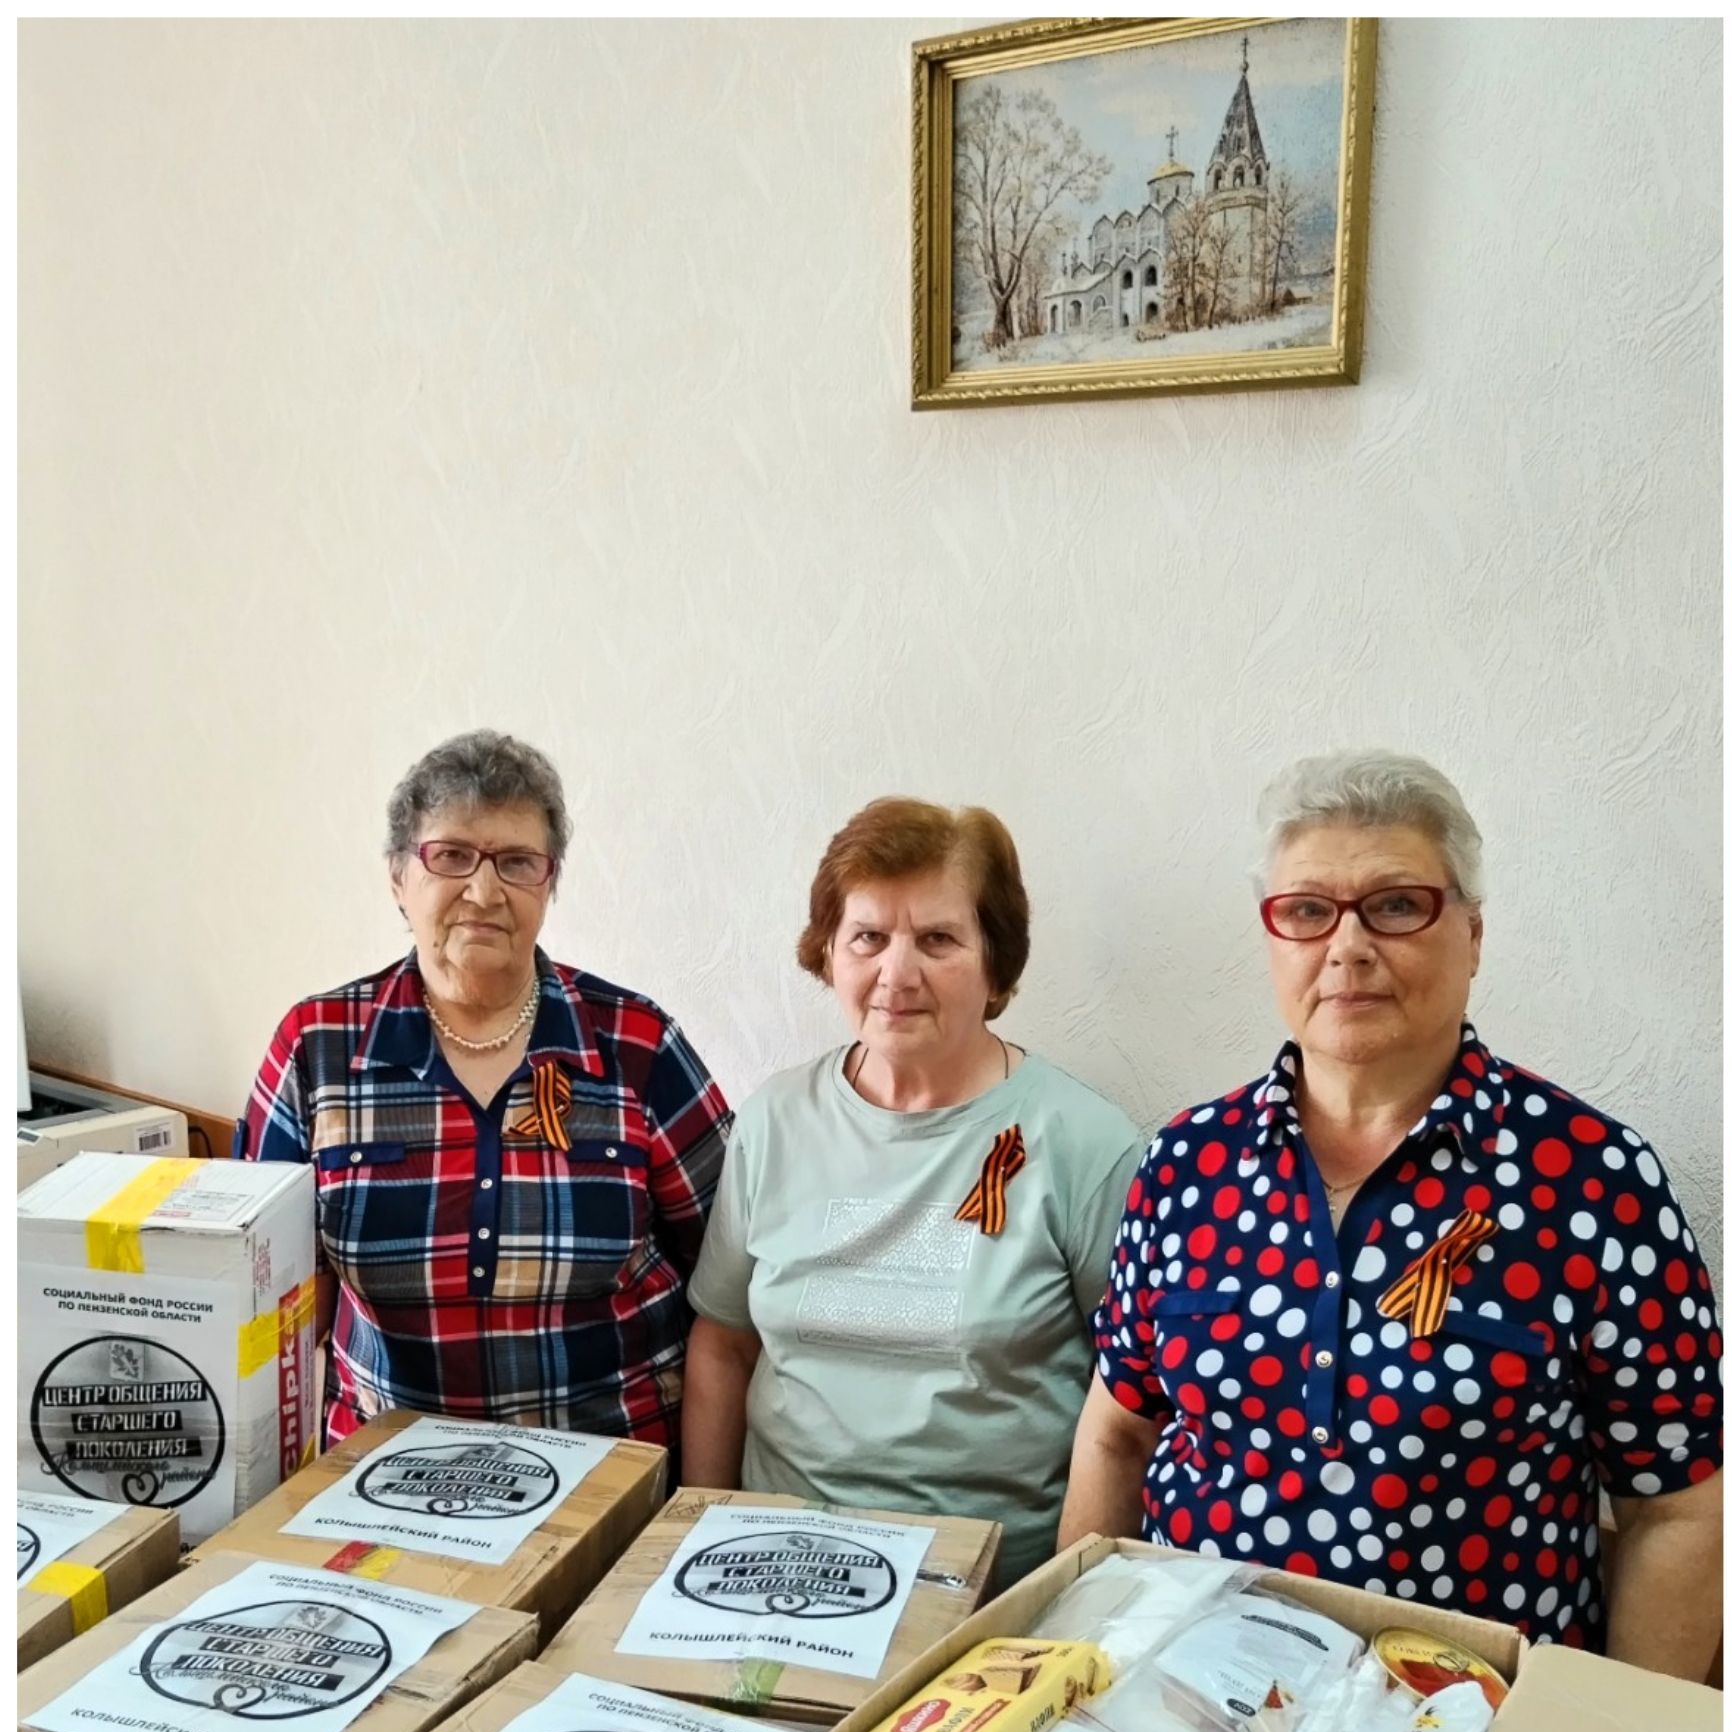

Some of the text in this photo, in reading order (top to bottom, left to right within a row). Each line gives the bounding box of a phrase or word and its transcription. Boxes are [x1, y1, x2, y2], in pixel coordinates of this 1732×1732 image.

[43, 1287, 213, 1313] СОЦИАЛЬНЫЙ ФОНД РОССИИ
[58, 1301, 202, 1323] ПО ПЕНЗЕНСКОЙ ОБЛАСТИ
[44, 1381, 203, 1406] ЦЕНТР ОБЩЕНИЯ
[76, 1411, 177, 1432] СТАРШЕГО
[76, 1439, 188, 1459] ПОКОЛЕНИЯ
[315, 1517, 493, 1549] КОЛЫШЛЕЙСКИЙ РАЙОН
[206, 1636, 336, 1667] СТАРШЕГО
[267, 1626, 382, 1658] ОБЩЕНИЯ
[795, 1641, 854, 1658] РАЙОН
[181, 1655, 327, 1688] ПОКОЛЕНИЯ
